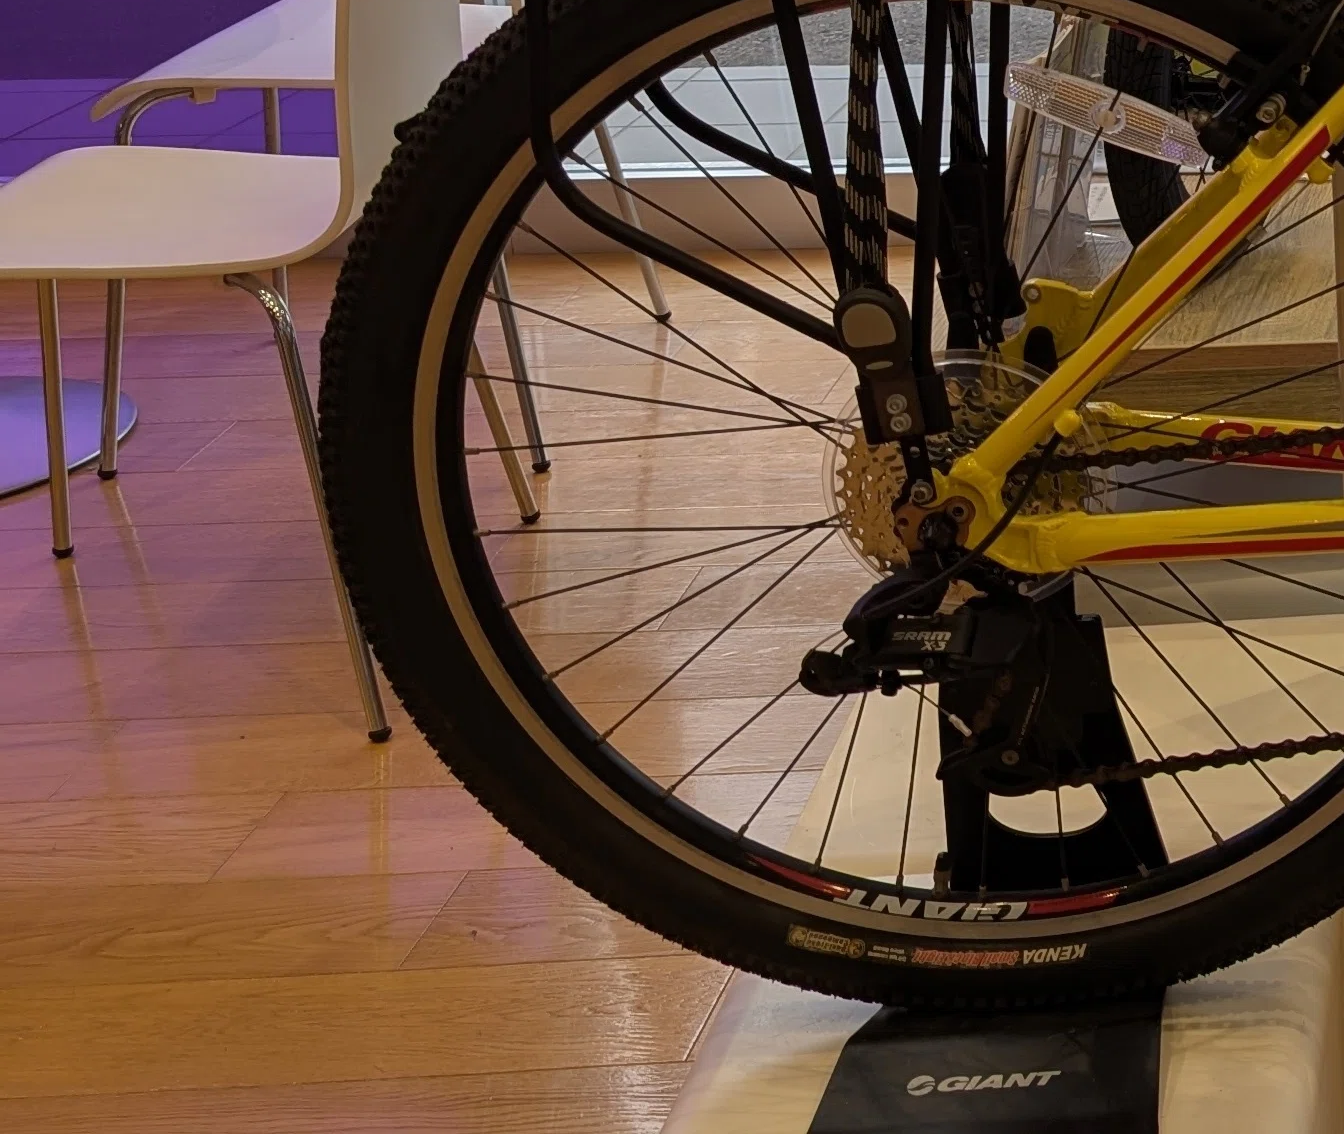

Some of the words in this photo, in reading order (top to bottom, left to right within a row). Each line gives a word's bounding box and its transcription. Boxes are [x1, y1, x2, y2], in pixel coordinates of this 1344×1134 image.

[892, 631, 951, 641] SRAM
[833, 888, 1028, 920] GIANT
[1023, 942, 1088, 964] KENDA
[936, 1069, 1062, 1094] GIANT
